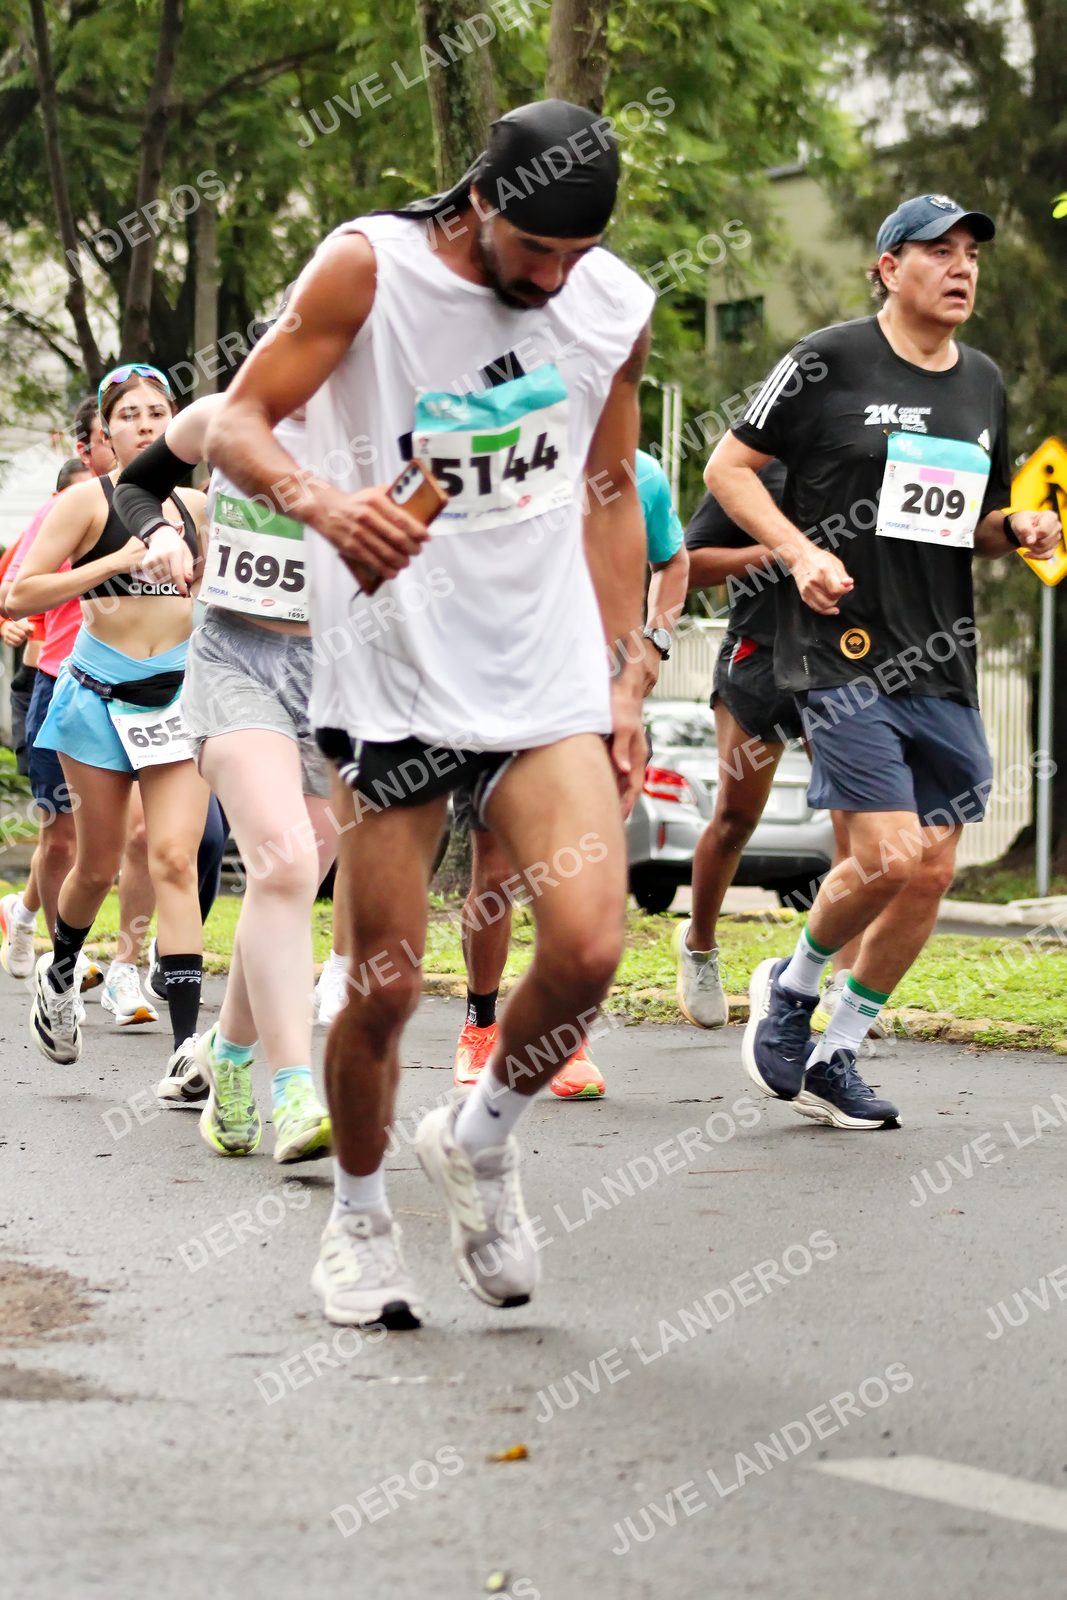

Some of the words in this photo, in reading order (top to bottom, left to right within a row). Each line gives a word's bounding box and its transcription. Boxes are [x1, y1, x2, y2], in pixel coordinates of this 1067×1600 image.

[864, 404, 899, 425] 2K
[431, 432, 559, 497] 5144
[901, 483, 965, 519] 209
[216, 544, 305, 593] 1695
[127, 715, 192, 748] 655
[165, 976, 202, 985] XTR
